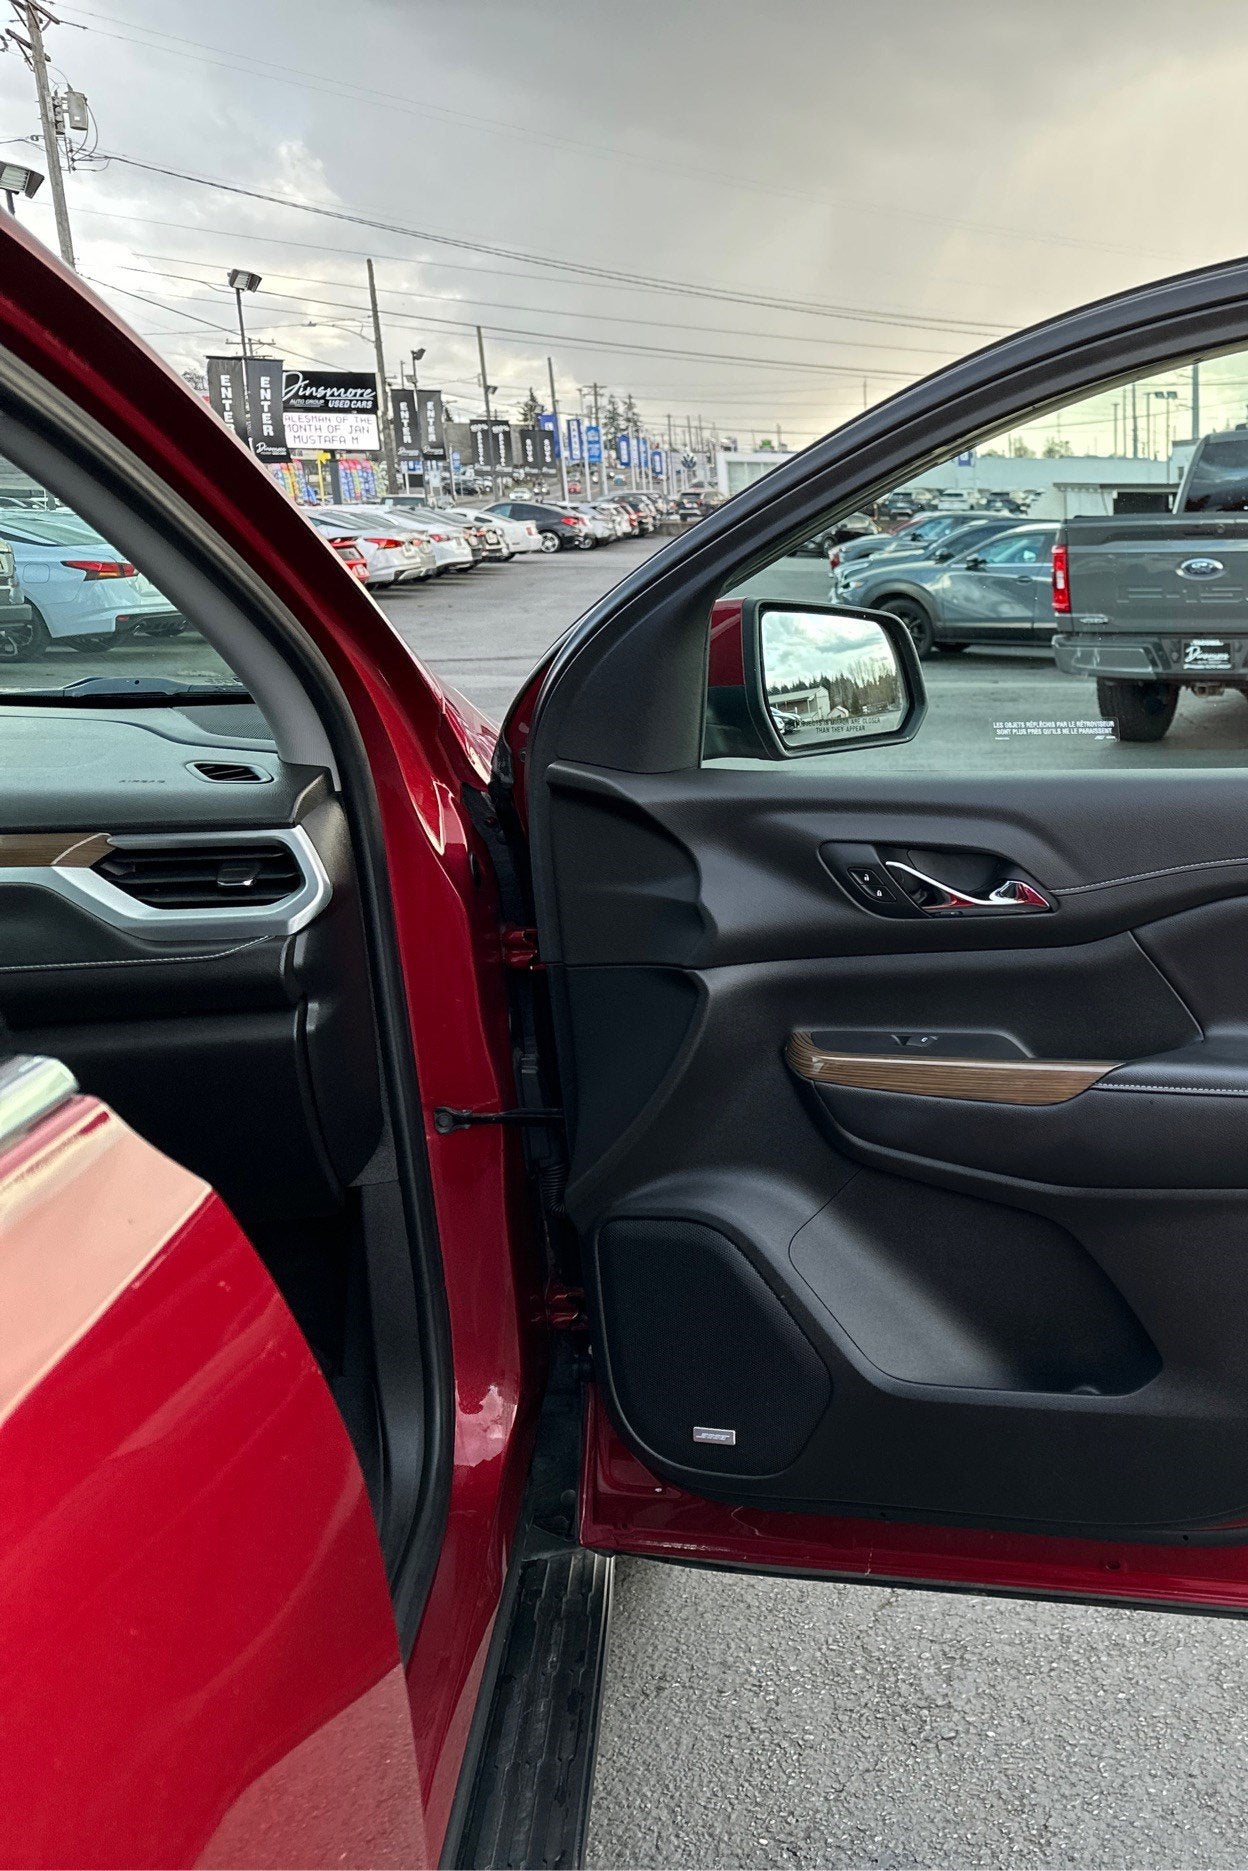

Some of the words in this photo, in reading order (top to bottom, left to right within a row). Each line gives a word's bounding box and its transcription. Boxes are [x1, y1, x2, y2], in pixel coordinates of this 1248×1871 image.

[281, 371, 376, 401] Dinsmore
[260, 376, 274, 436] ENTER
[328, 400, 350, 408] USED
[350, 400, 373, 409] CARS
[284, 414, 331, 424] ALESMAN
[335, 415, 349, 424] OF
[354, 416, 373, 425] THE
[400, 401, 412, 444] ENTER
[426, 401, 437, 442] ENTER
[326, 424, 341, 434] OF
[348, 425, 370, 435] JAN
[293, 434, 347, 445] MUSTAFA
[351, 435, 359, 445] M
[845, 725, 866, 733] APPEAR
[993, 721, 1004, 729] LES
